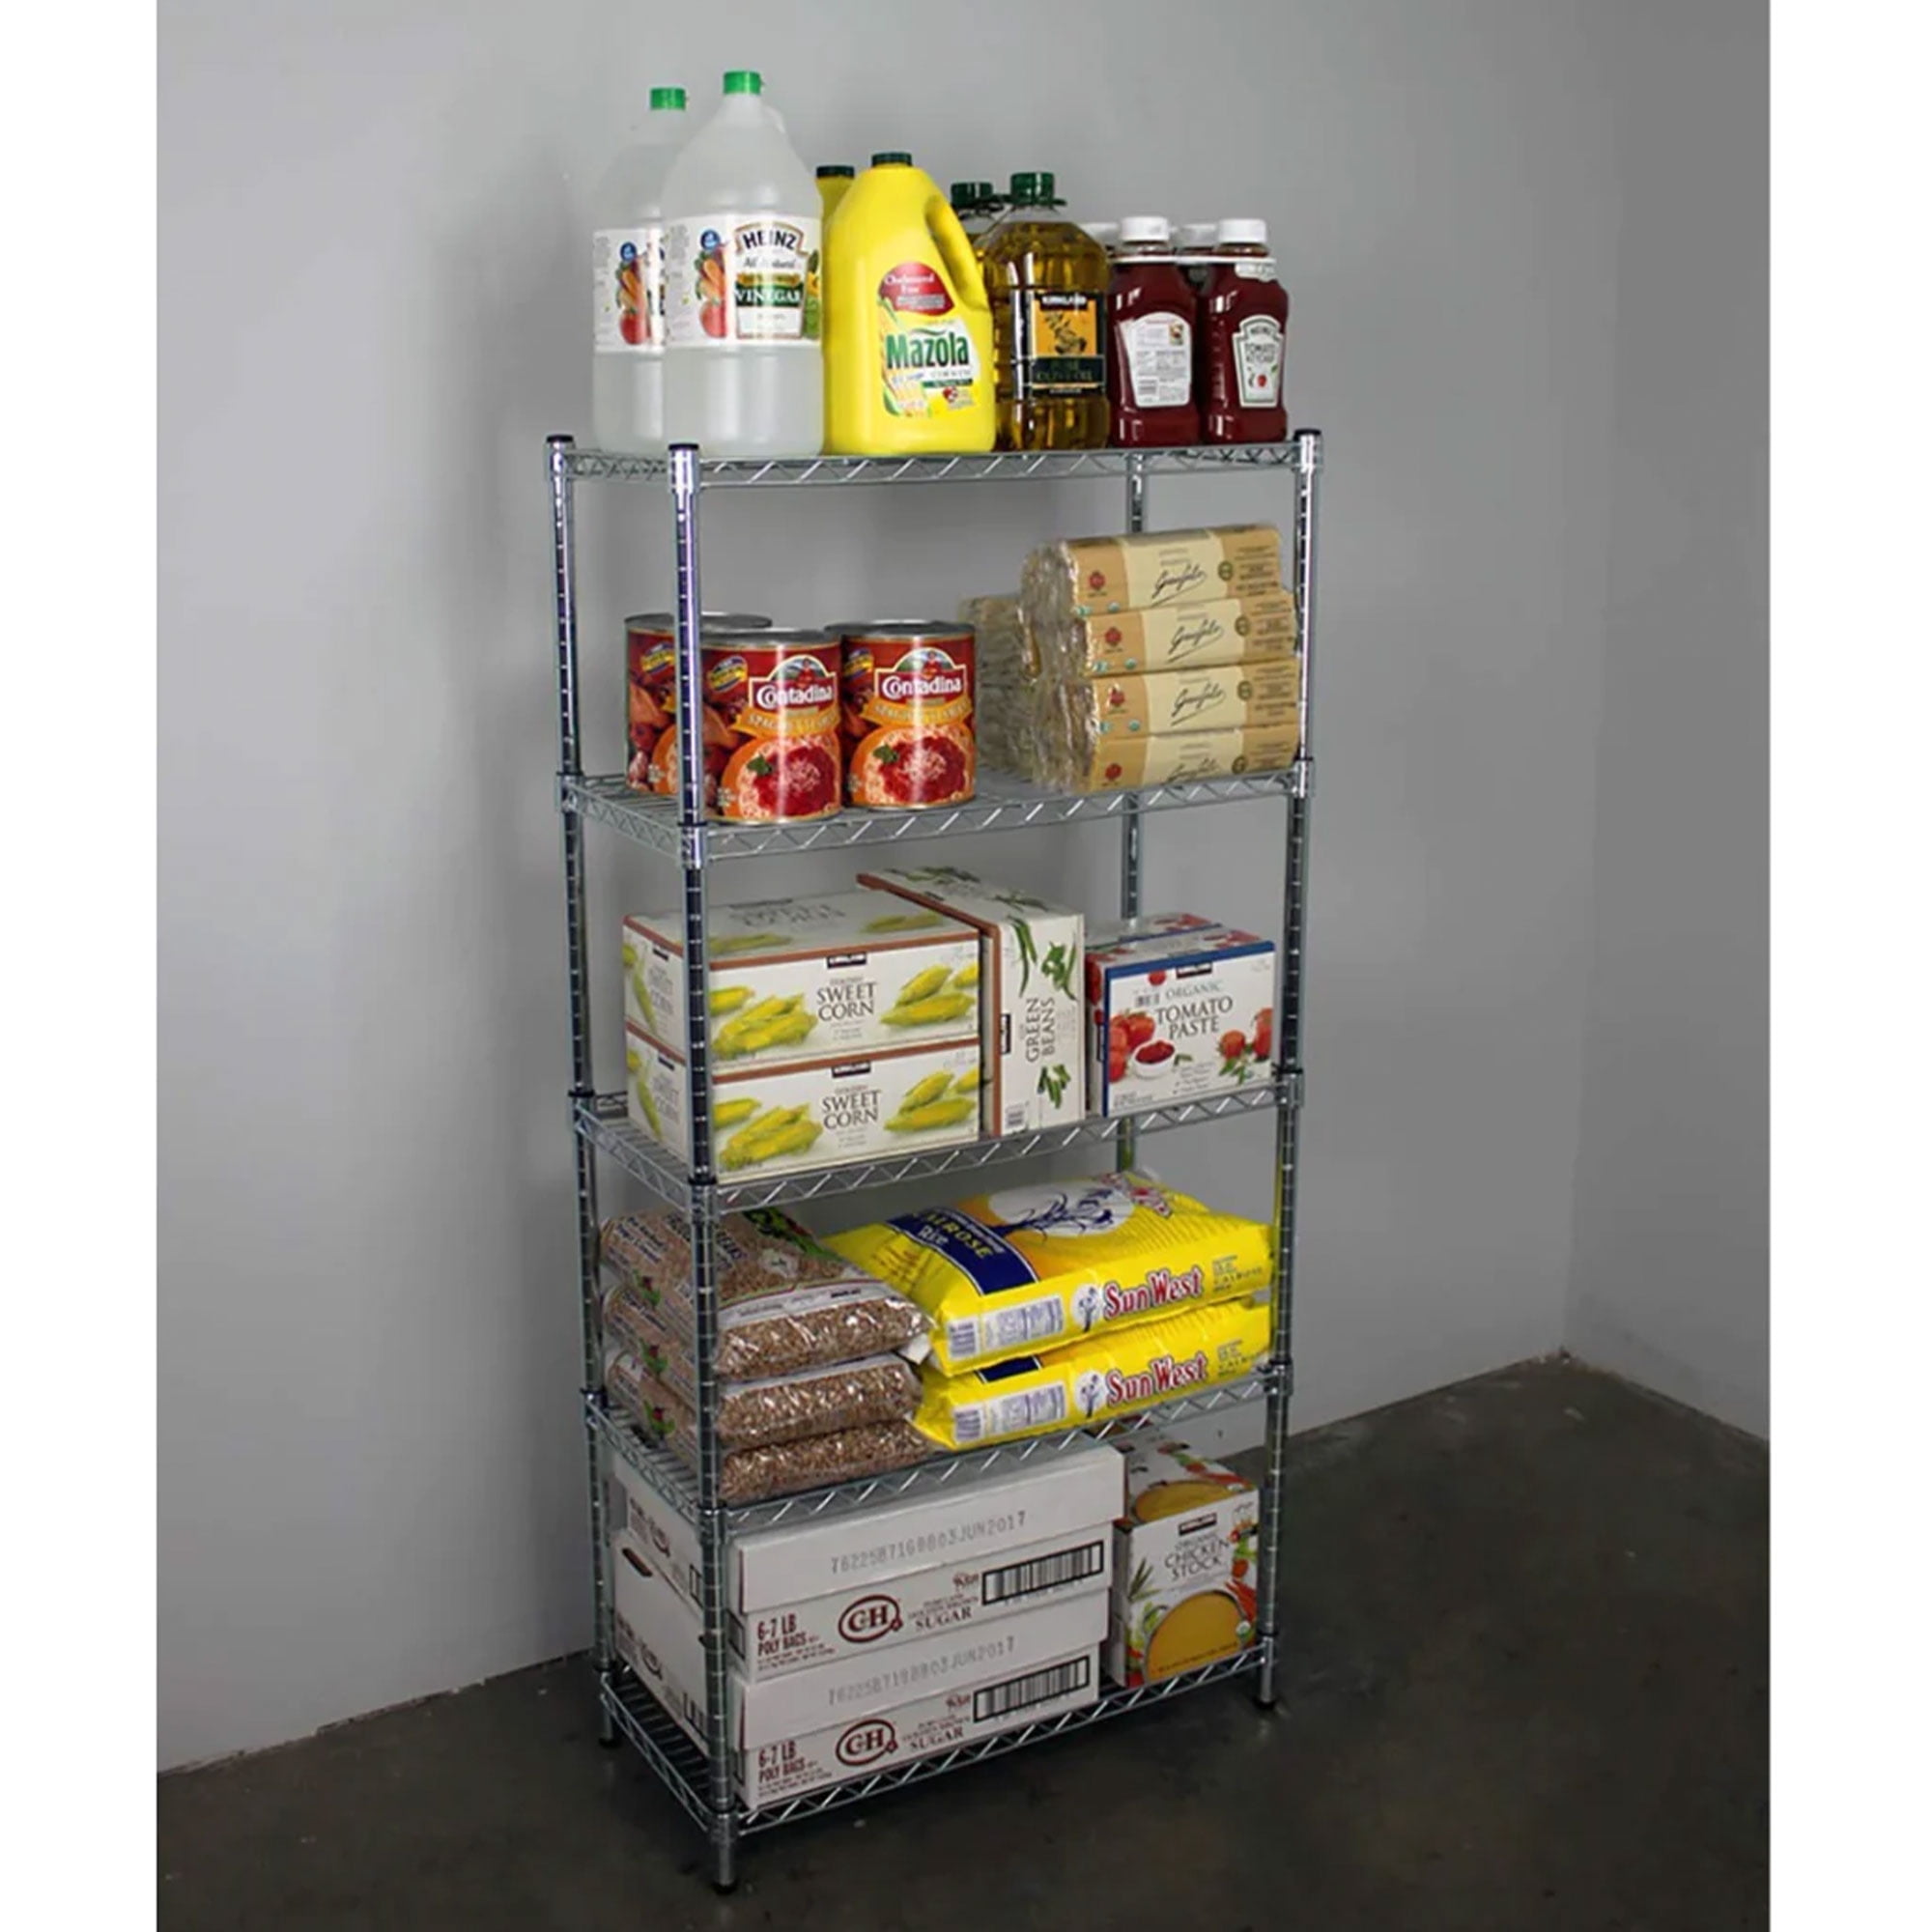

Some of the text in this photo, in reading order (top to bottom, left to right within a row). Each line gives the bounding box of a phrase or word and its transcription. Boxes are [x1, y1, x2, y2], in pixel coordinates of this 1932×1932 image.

[743, 230, 797, 250] HEINZ
[886, 331, 970, 369] Mazola
[756, 685, 834, 710] Contadina
[881, 675, 963, 700] Contadina
[816, 980, 878, 1006] SWEET
[1166, 979, 1223, 1002] ORGANIC
[818, 1000, 874, 1022] CORN
[1155, 996, 1233, 1025] TOMATO
[1025, 997, 1040, 1063] GREEN
[1040, 997, 1056, 1056] BEANS
[1170, 1015, 1219, 1040] PASTE
[822, 1090, 883, 1114] SWEET
[824, 1107, 878, 1130] CORN
[917, 1225, 949, 1246] Rice
[1164, 1539, 1230, 1569] CHICKEN
[1172, 1555, 1222, 1582] STOCK
[757, 1612, 797, 1641] 6-7 LB
[915, 1605, 973, 1632] SUGAR
[758, 1636, 780, 1657] POLY
[909, 1725, 964, 1752] SUGAR
[758, 1740, 796, 1768] 6-7 LB
